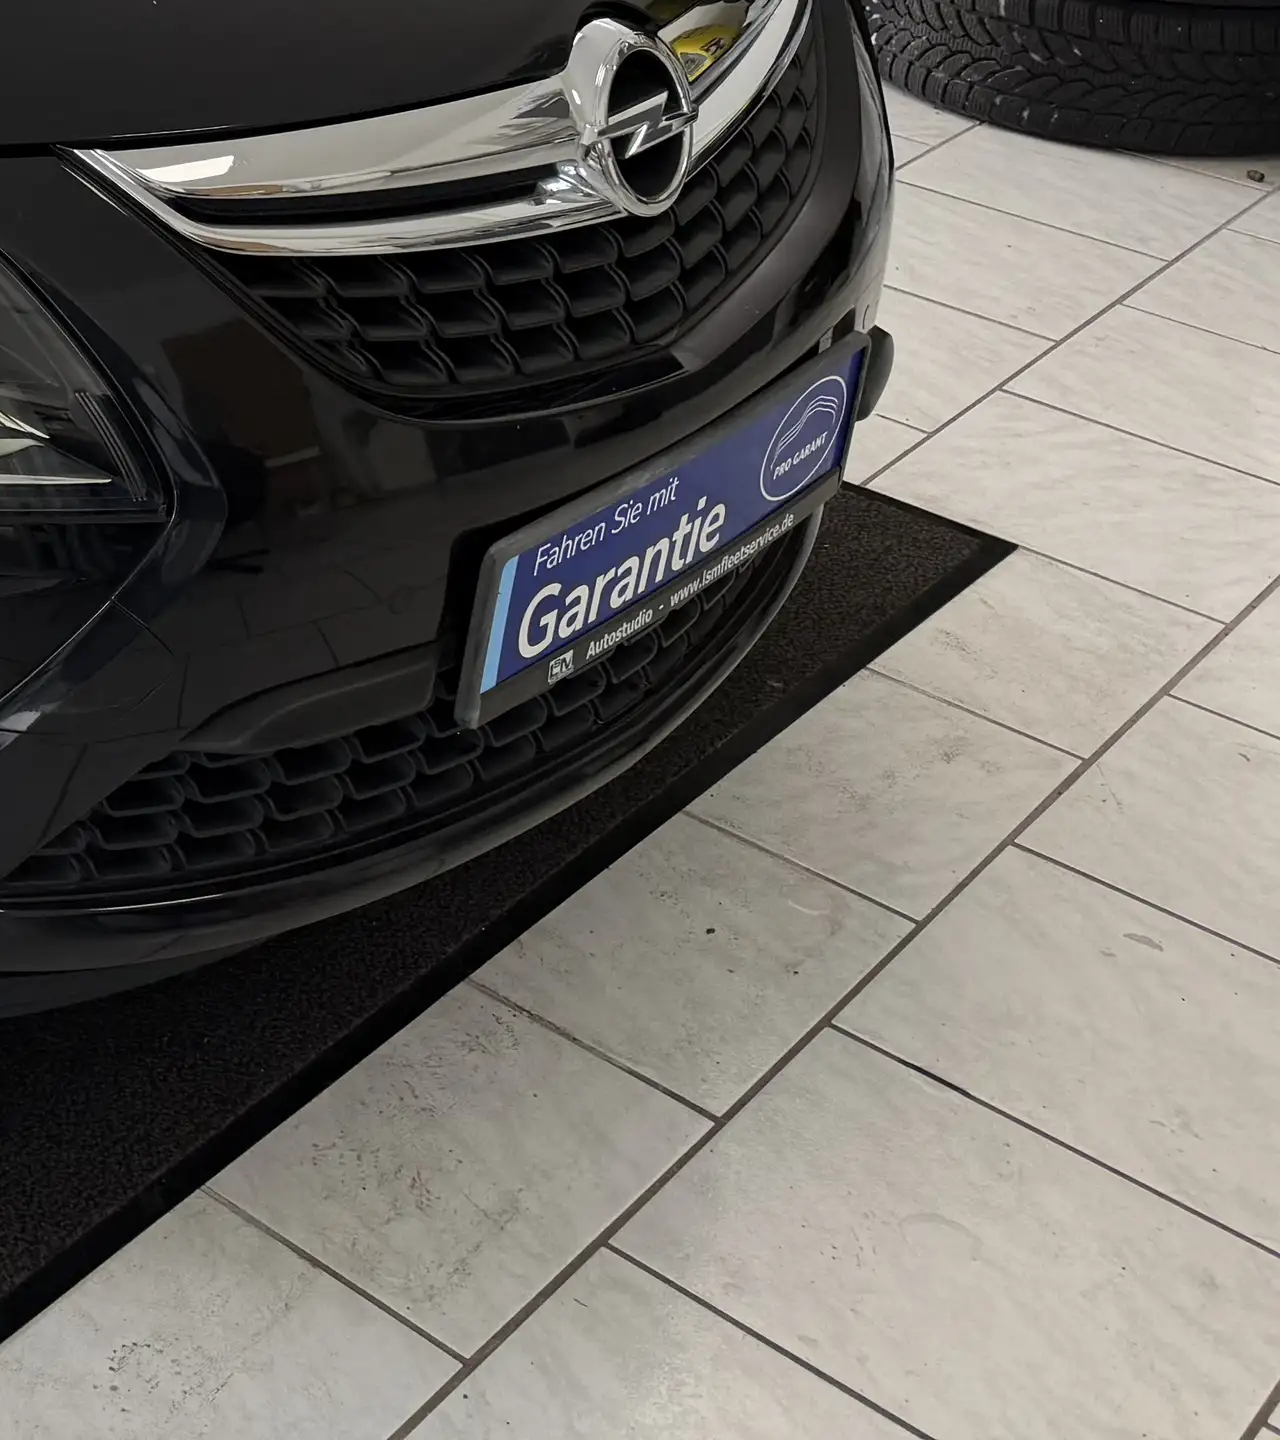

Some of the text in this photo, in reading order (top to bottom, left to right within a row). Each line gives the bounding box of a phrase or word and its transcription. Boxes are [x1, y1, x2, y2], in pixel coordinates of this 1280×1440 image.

[772, 430, 828, 480] PRO GARANT
[518, 495, 726, 659] Garantie
[533, 476, 680, 576] Fahren Sie mit
[585, 607, 653, 660] Autostudio
[669, 512, 795, 608] www.lsmfleetservice.de
